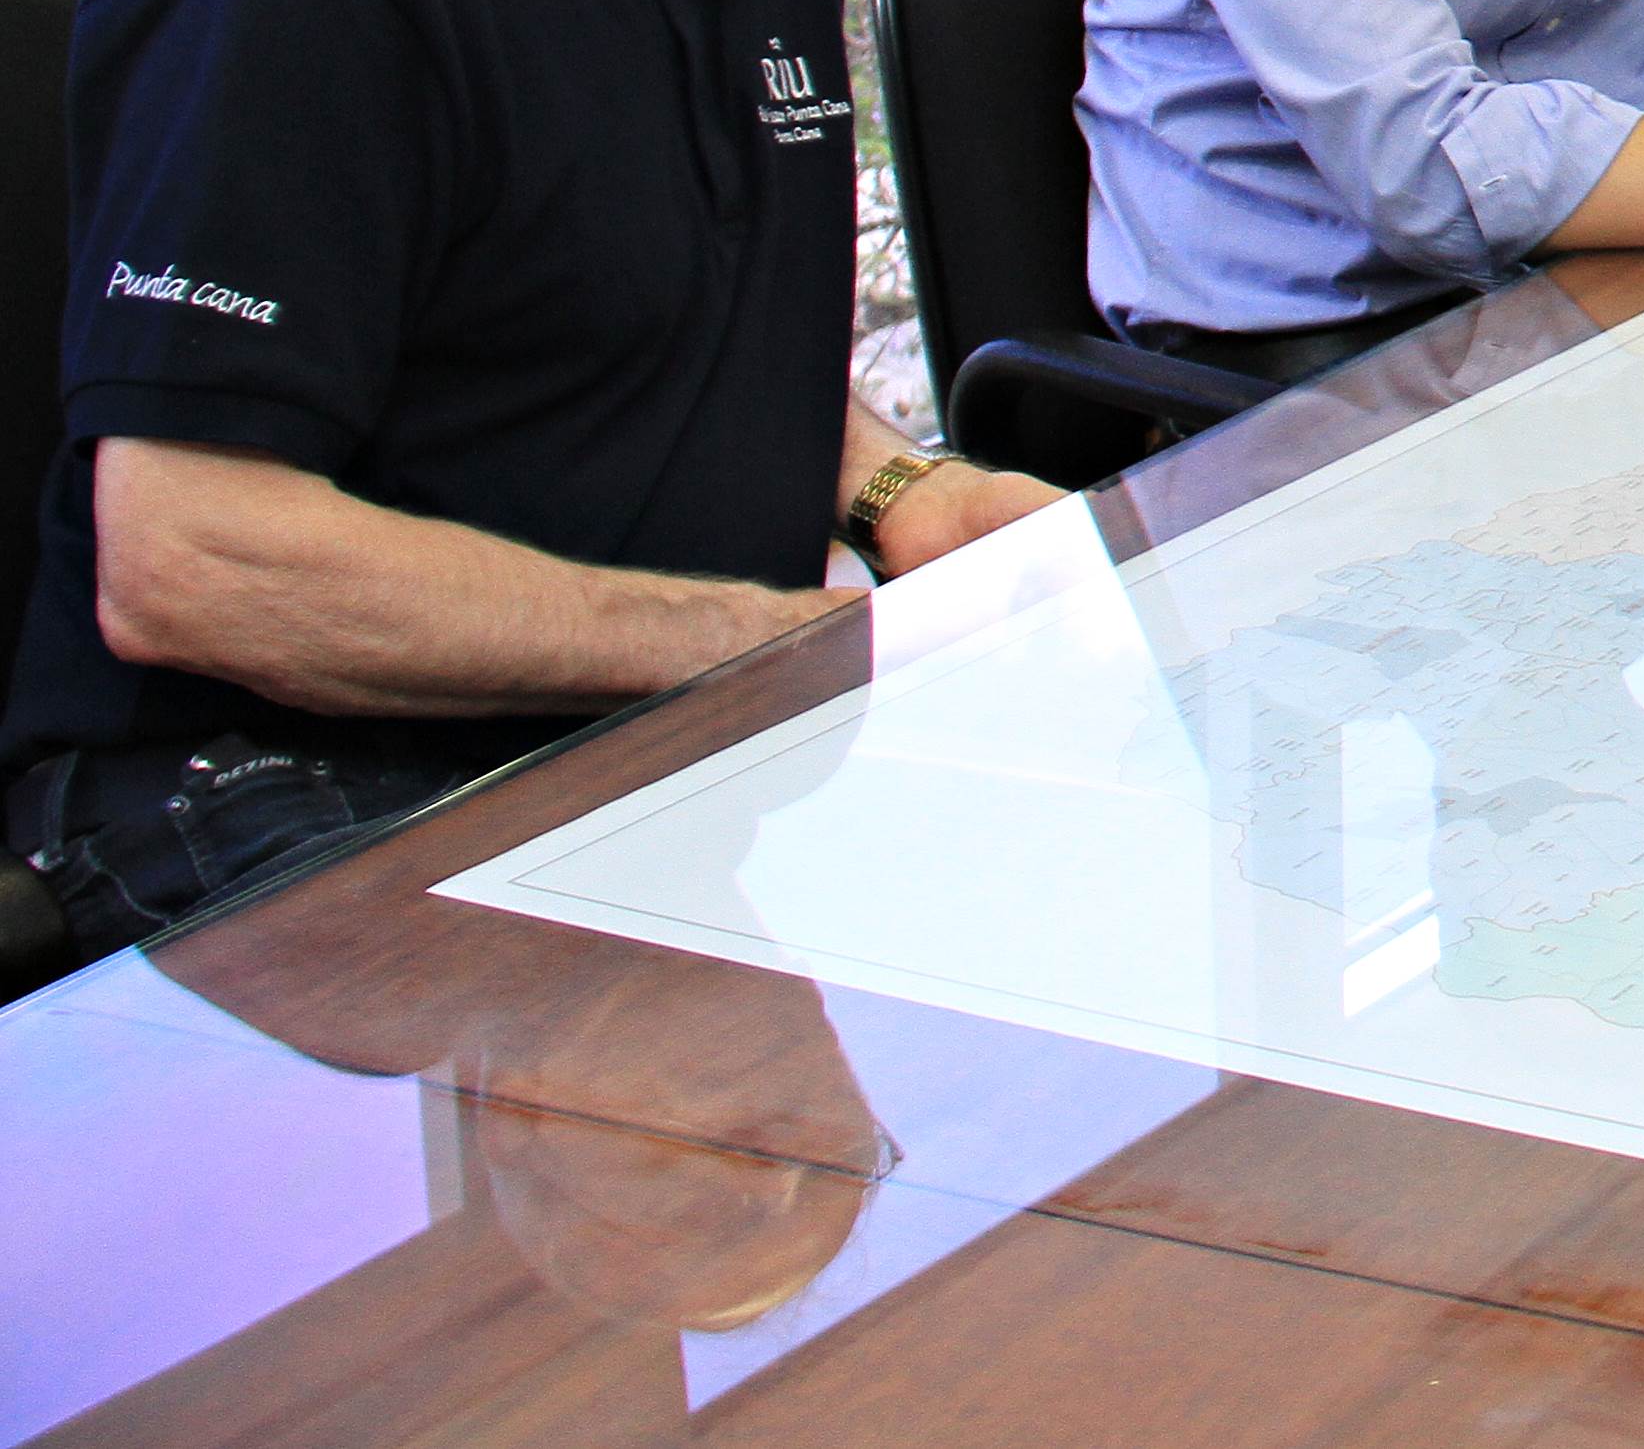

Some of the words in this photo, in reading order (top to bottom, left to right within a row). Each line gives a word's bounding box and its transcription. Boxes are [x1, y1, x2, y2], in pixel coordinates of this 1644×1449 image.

[759, 55, 815, 101] RIU
[822, 99, 852, 115] Cana
[105, 259, 191, 301] Punta
[190, 281, 279, 324] cana
